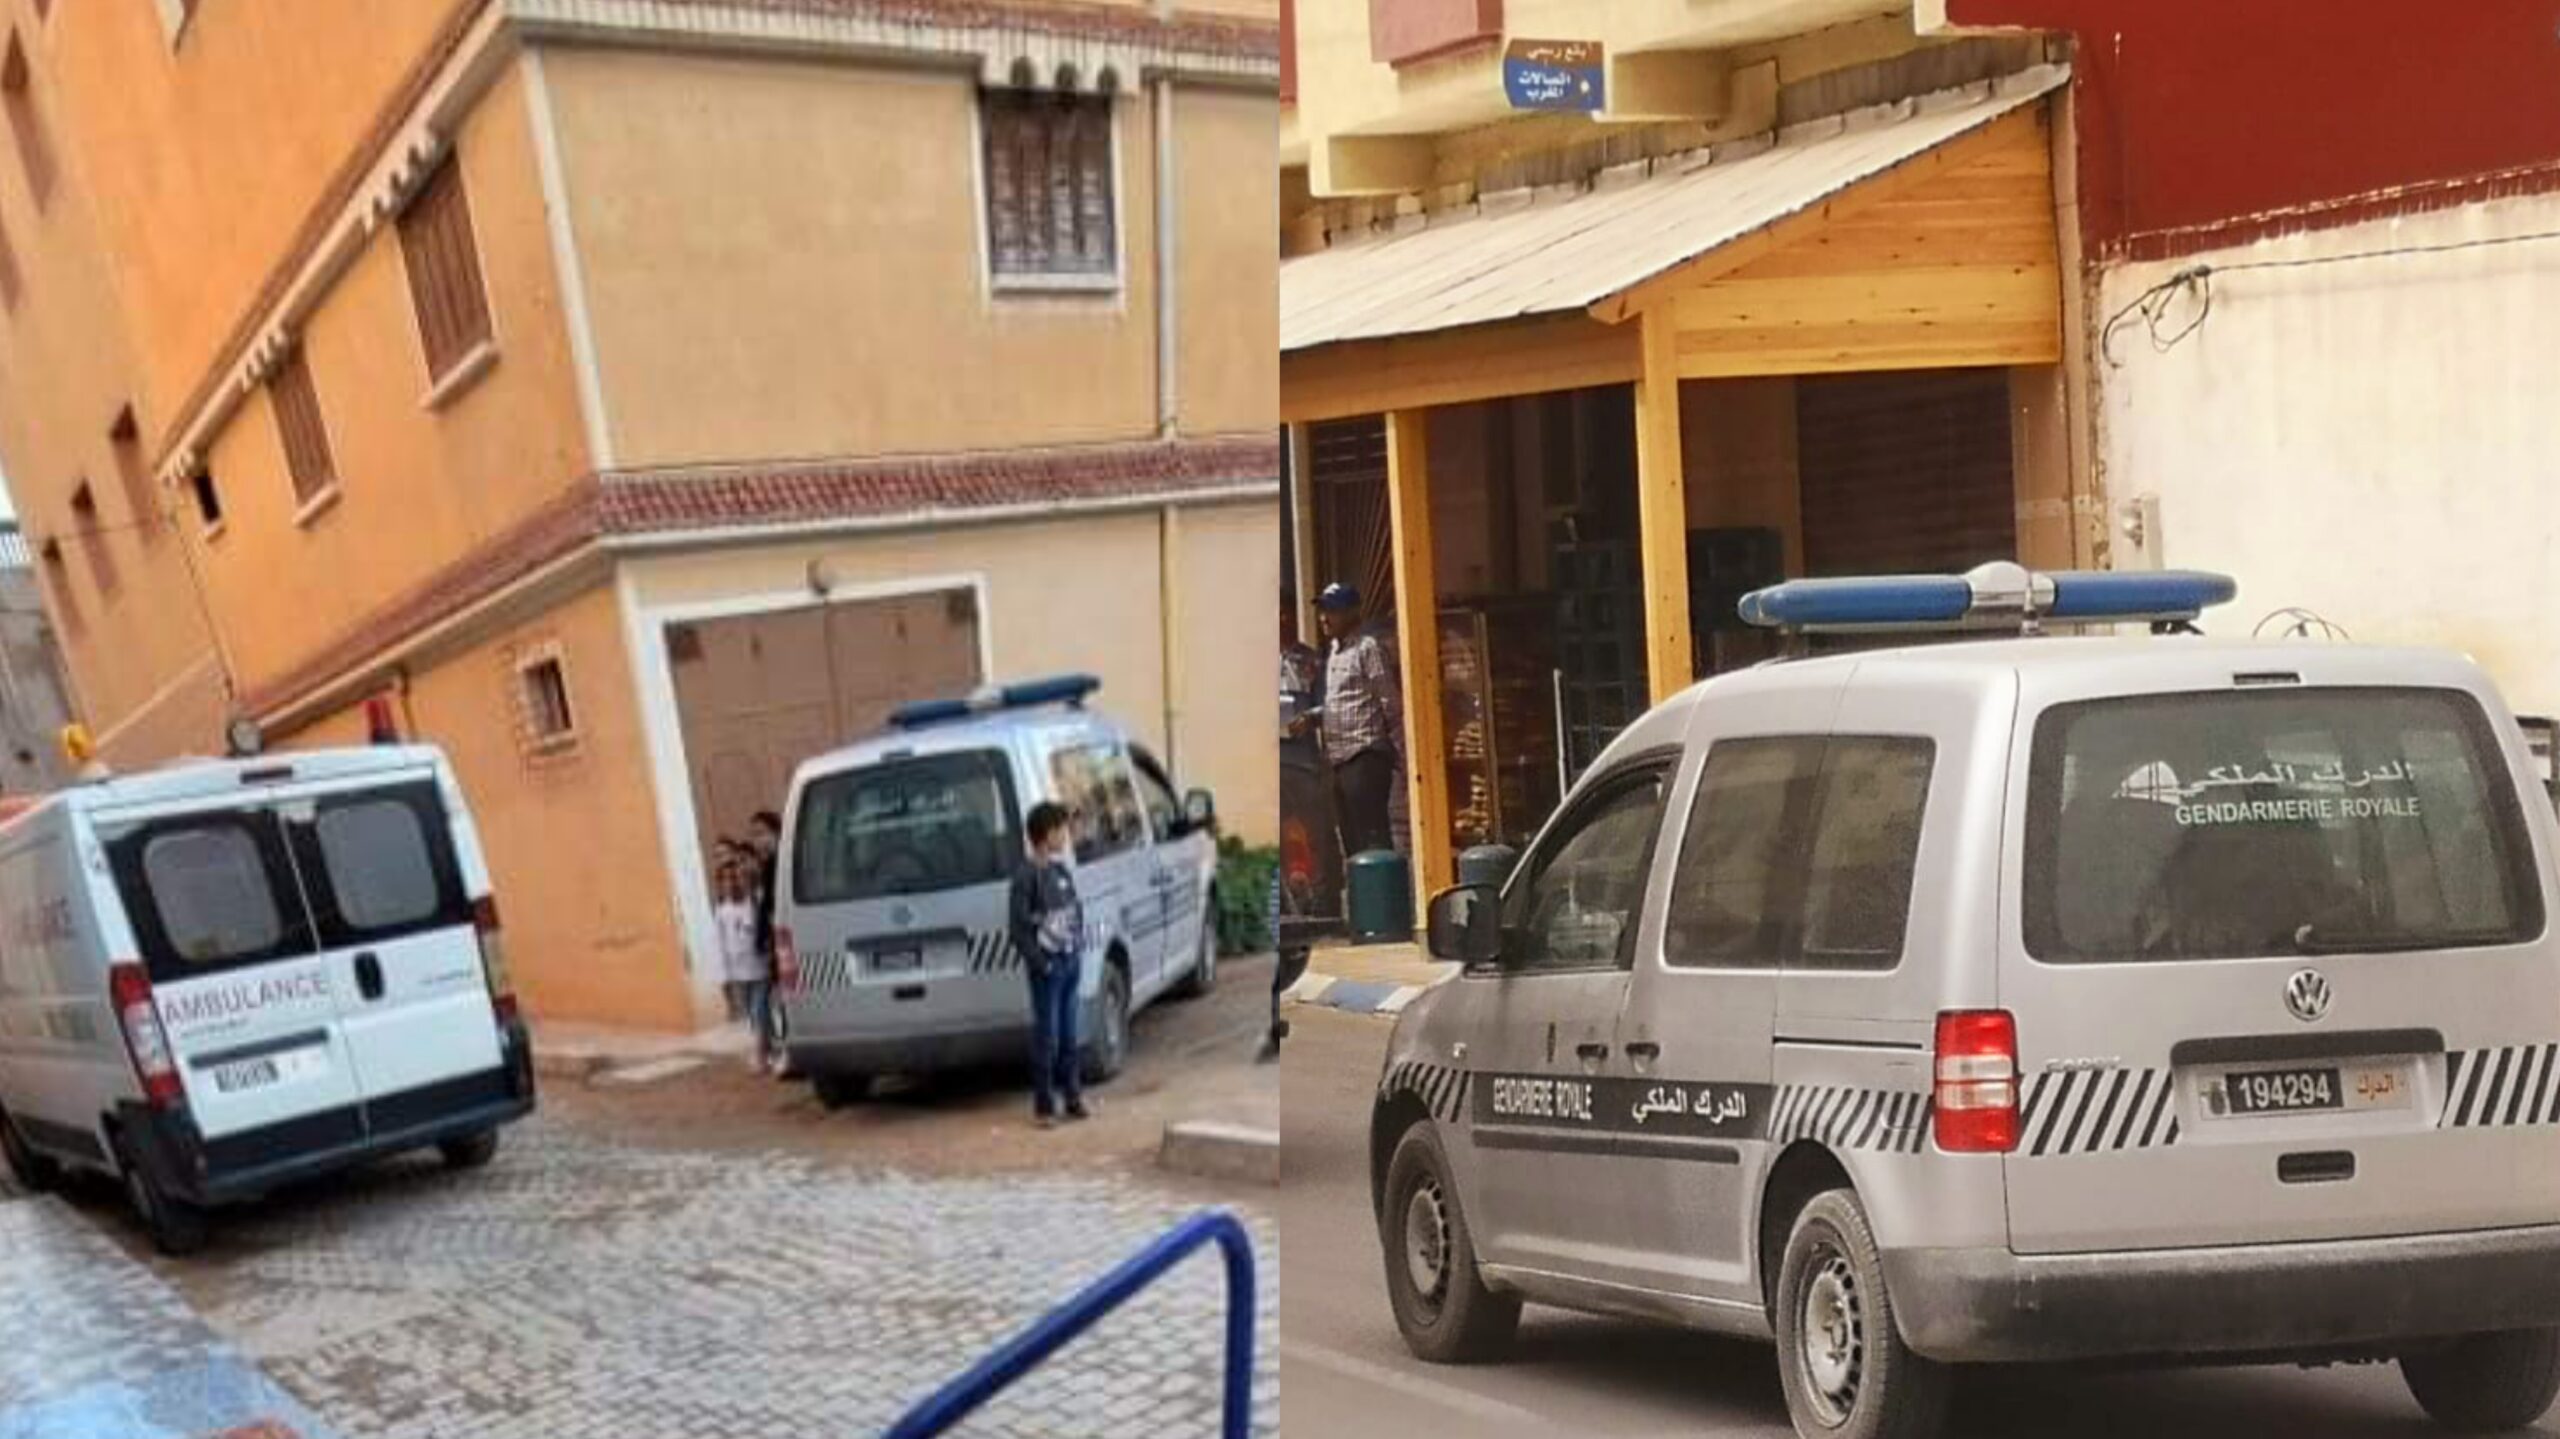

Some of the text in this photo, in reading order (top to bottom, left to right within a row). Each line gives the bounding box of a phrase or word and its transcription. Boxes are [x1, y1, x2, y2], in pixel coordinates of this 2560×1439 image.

[2311, 760, 2415, 787] الدرك
[2175, 797, 2421, 826] GENDARMERIE ROYALE
[163, 971, 329, 1026] AMBULANCE
[1494, 1078, 1592, 1120] GENDARMERIE ROYALE
[2238, 1074, 2332, 1108] 194294
[2356, 1073, 2394, 1100] الدرك
[1631, 1087, 1747, 1124] الدرك الملكي
